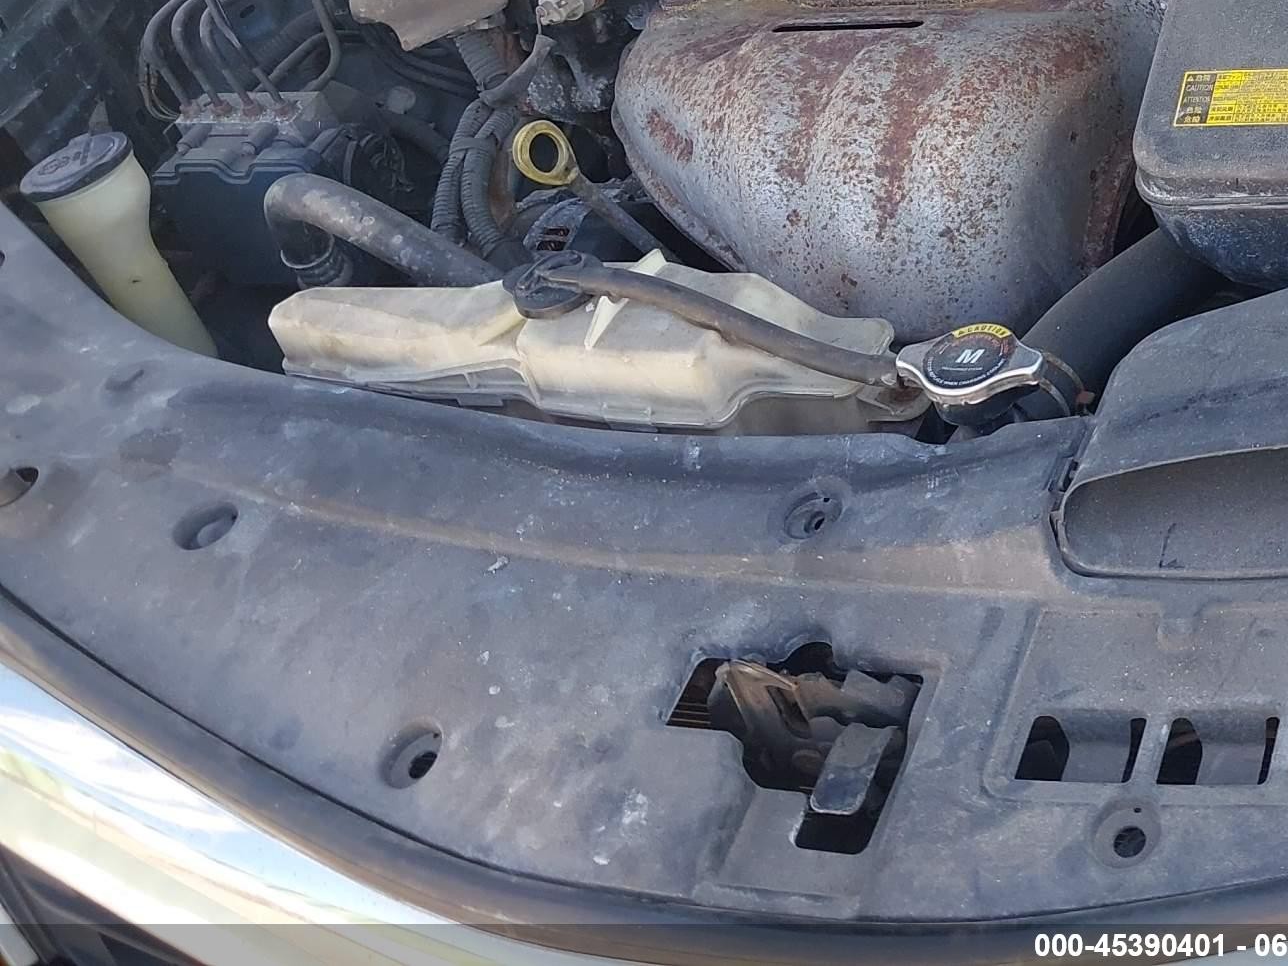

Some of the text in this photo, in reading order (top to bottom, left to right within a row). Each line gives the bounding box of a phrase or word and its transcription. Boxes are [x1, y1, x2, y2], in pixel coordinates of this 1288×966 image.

[1186, 84, 1213, 92] CAUTION
[1184, 96, 1211, 104] ATTENTION
[967, 324, 1007, 336] CAUTION
